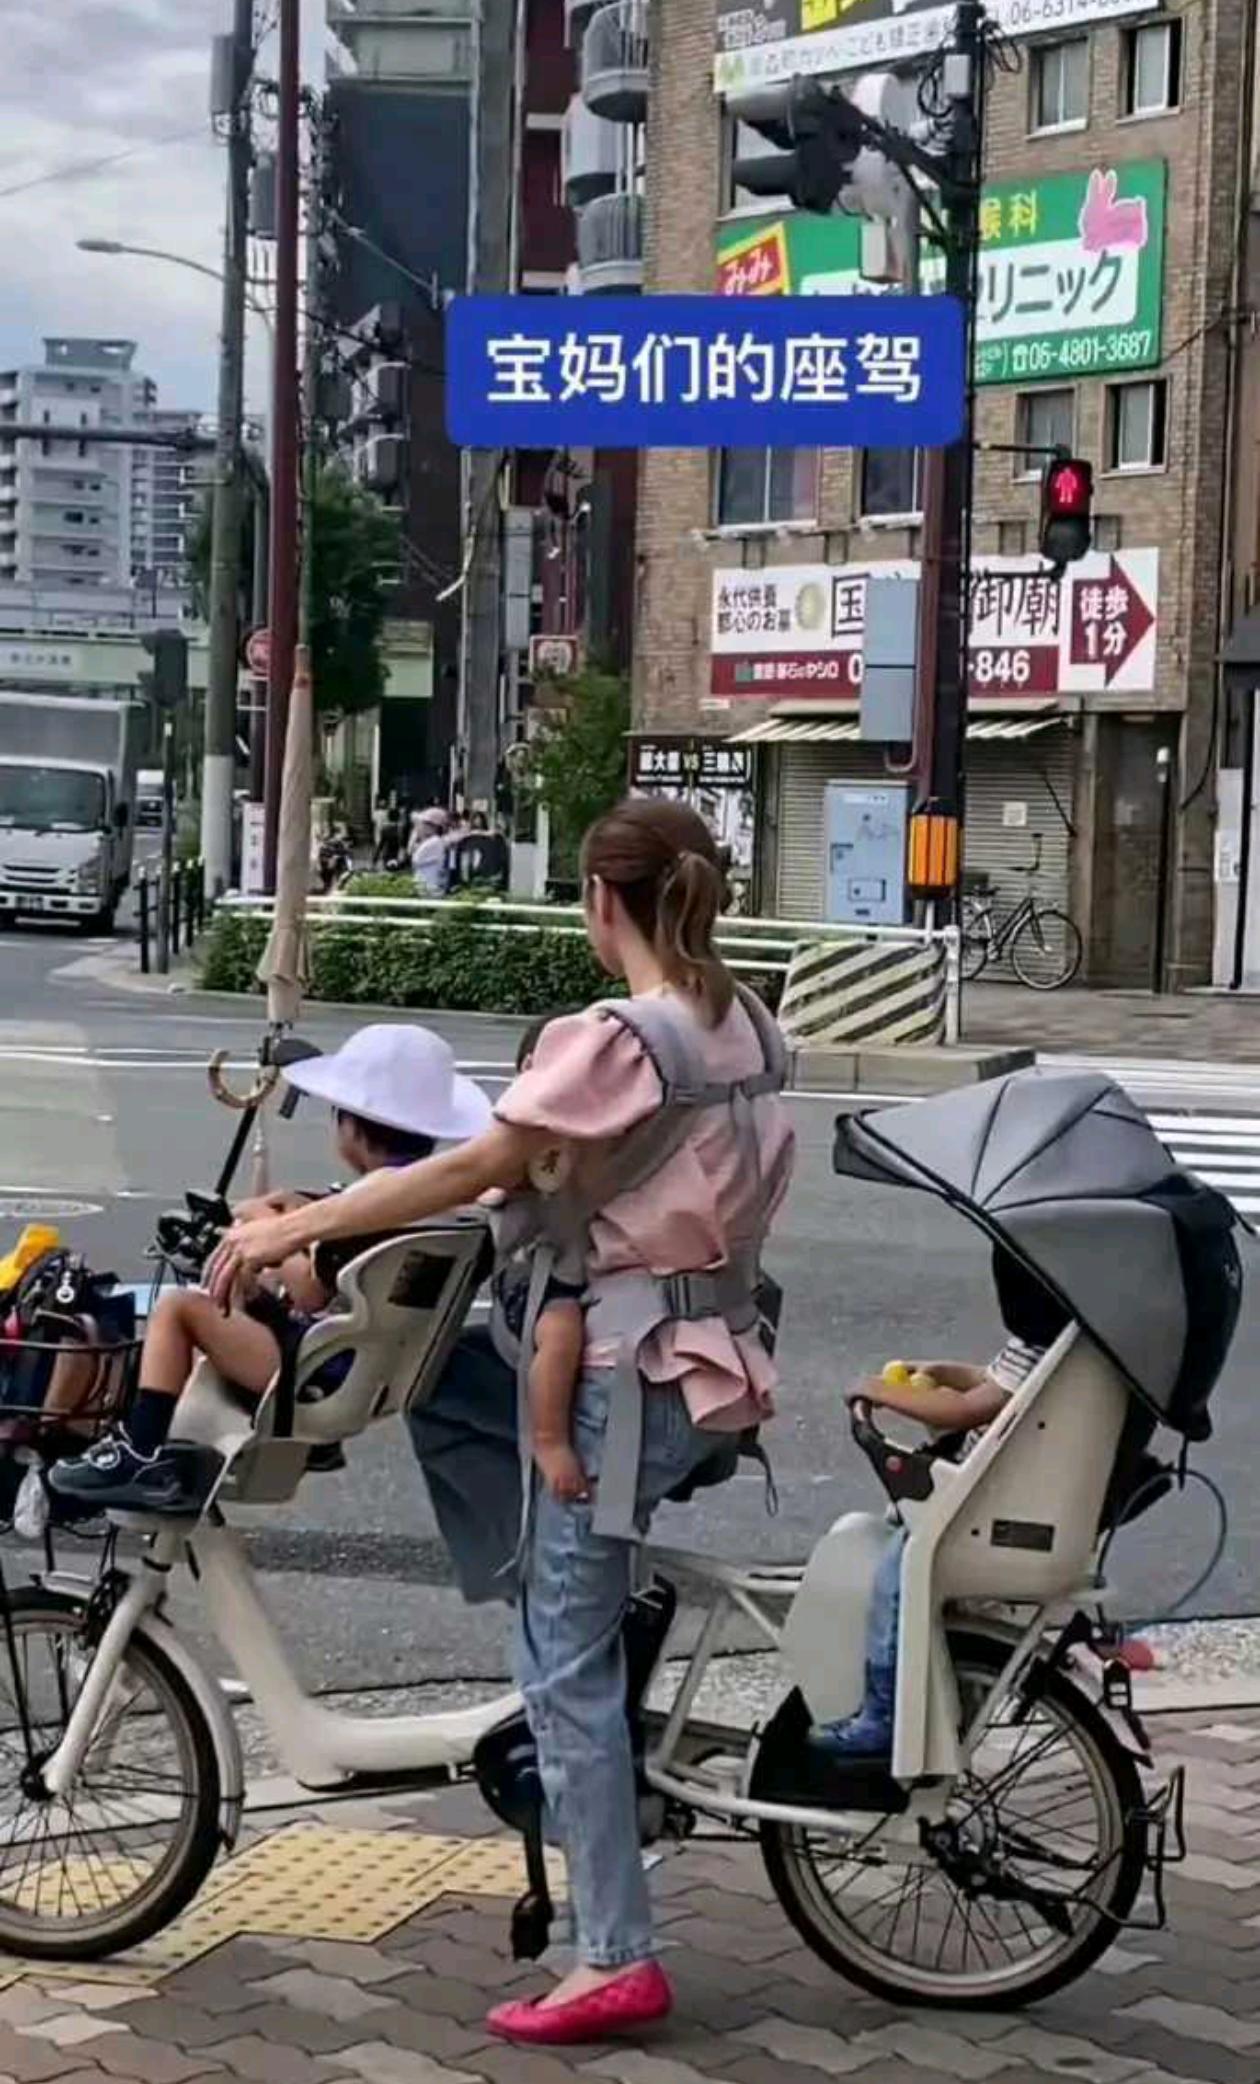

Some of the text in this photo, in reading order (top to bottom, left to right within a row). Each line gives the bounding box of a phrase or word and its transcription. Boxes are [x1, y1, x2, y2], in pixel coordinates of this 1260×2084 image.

[976, 249, 1122, 323] リニック
[1029, 331, 1152, 371] 06-4801-3687
[1079, 585, 1129, 622] 徒歩
[1083, 622, 1128, 659] 1分
